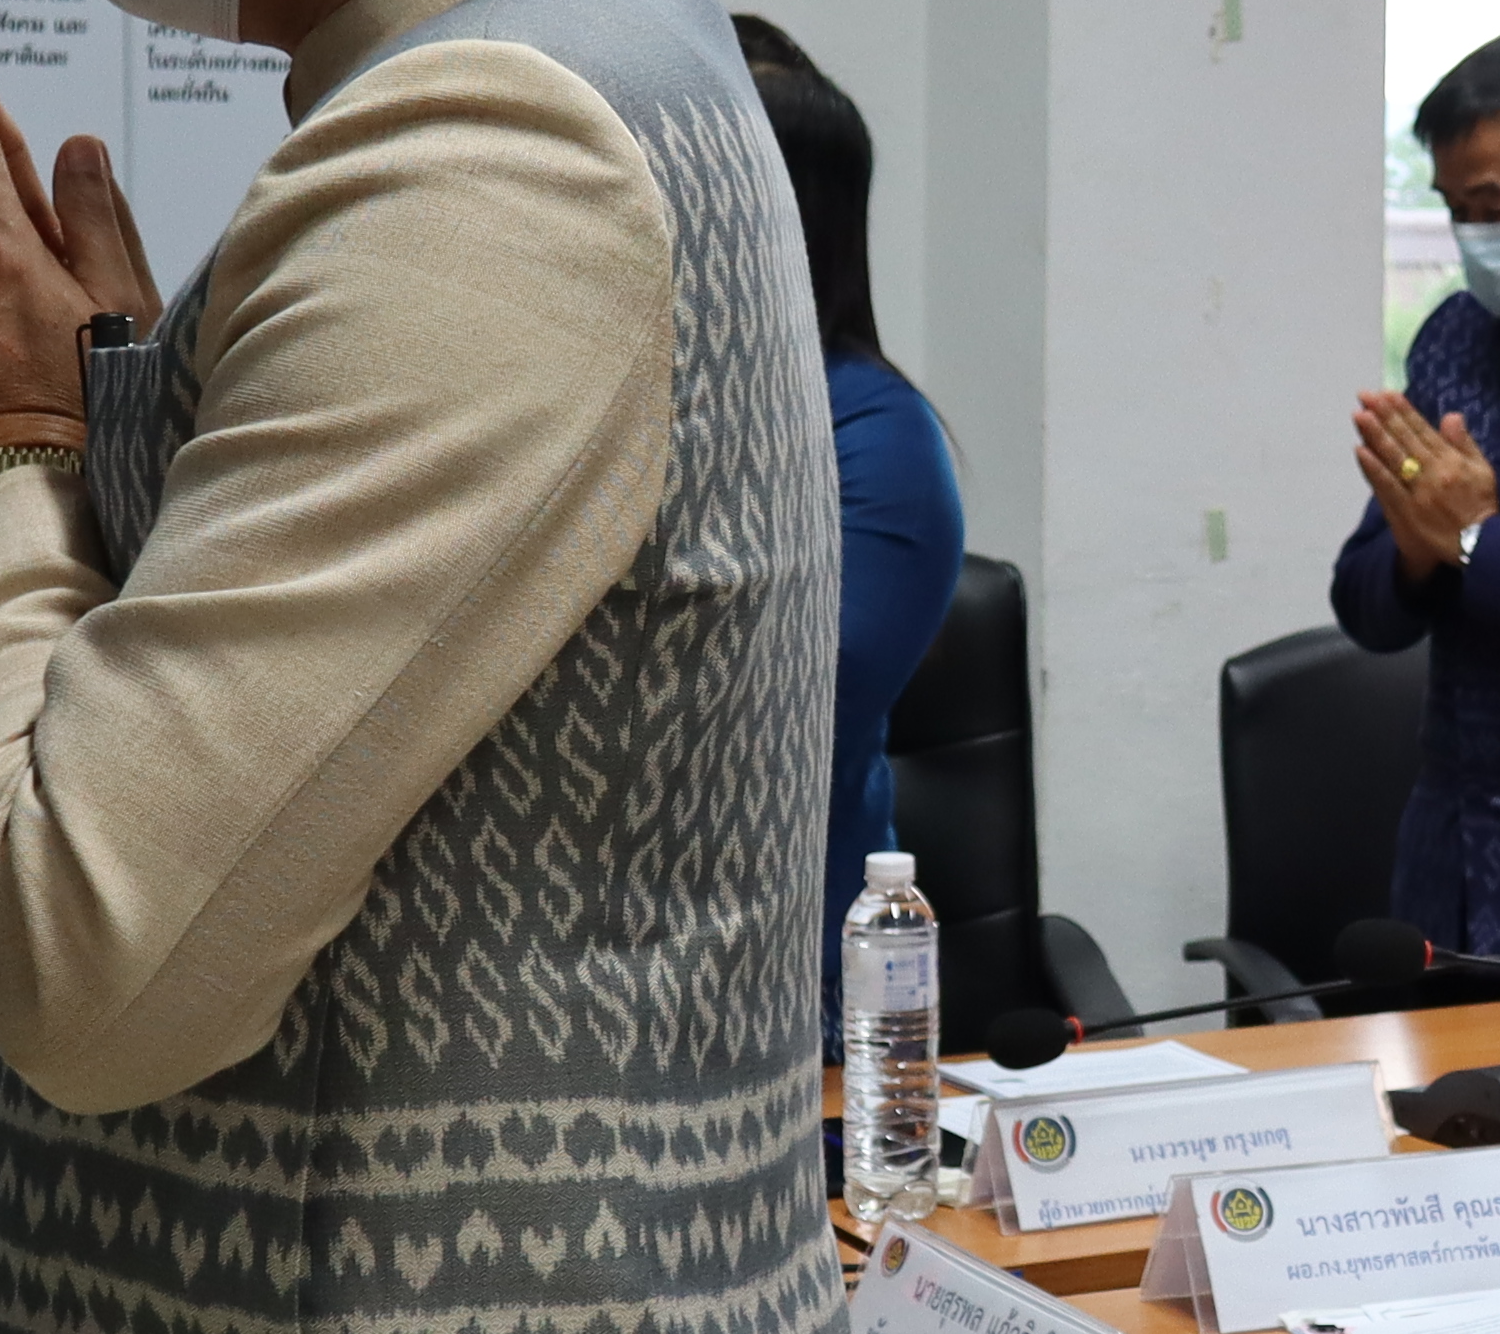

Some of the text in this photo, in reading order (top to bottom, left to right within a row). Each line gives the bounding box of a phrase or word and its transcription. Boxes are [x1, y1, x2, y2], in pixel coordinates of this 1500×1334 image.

[1128, 1134, 1217, 1163] นางวรนุช
[1296, 1193, 1445, 1238] นางสาวพันสี
[912, 1275, 985, 1333] นายสุรพล
